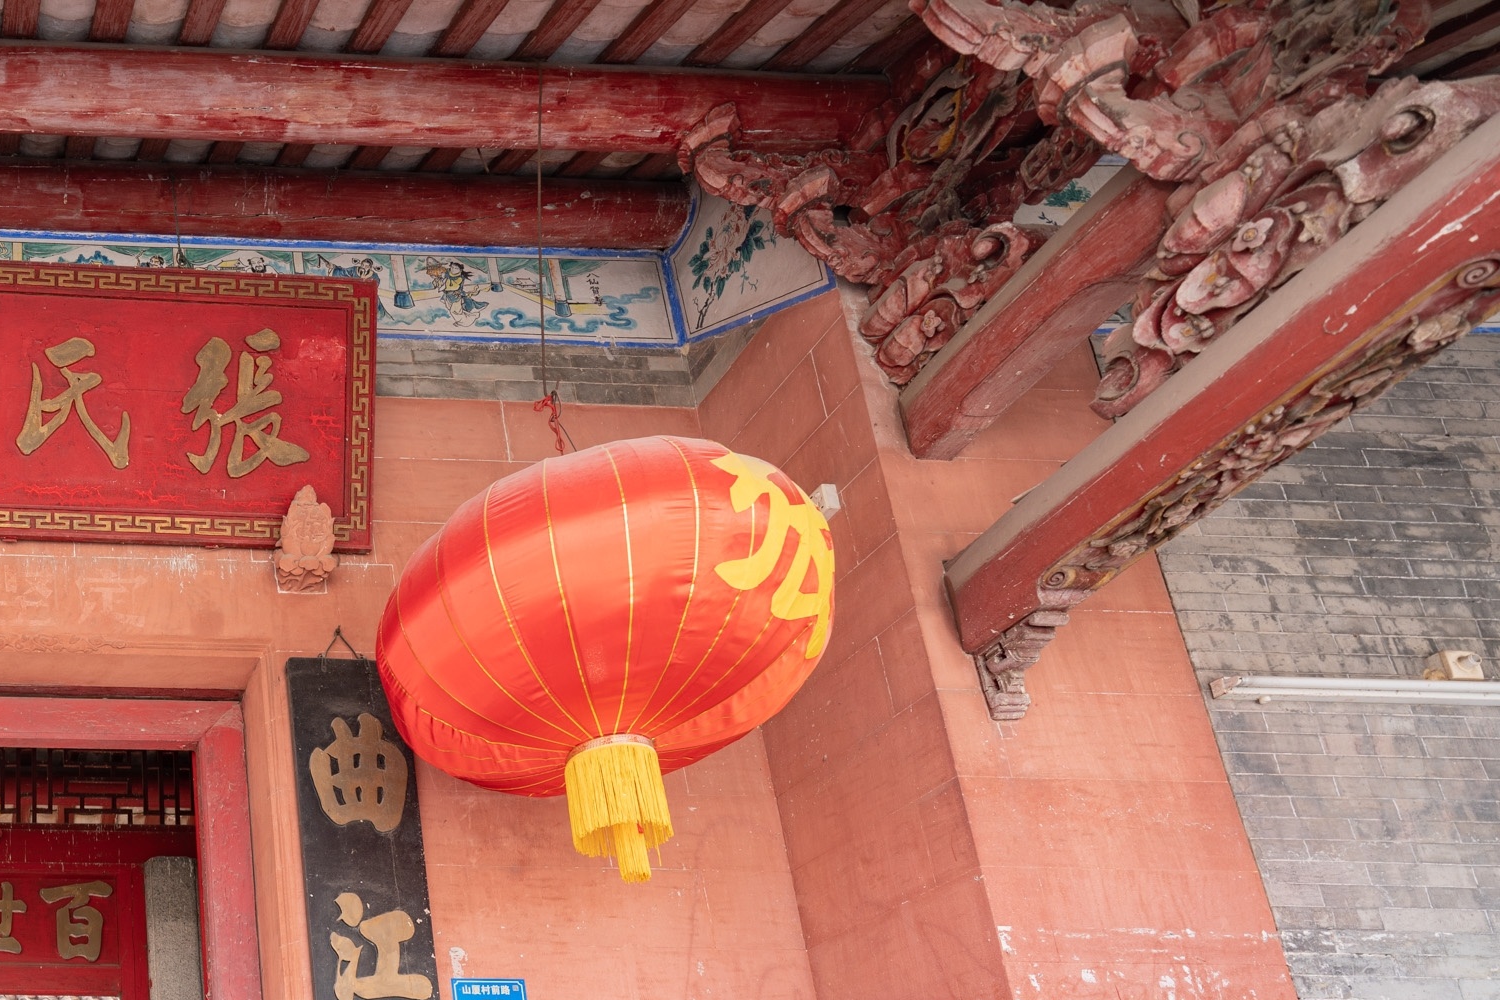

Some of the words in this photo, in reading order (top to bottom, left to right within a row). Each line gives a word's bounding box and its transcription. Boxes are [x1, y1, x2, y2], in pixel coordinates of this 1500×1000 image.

[461, 984, 511, 996] 山厦村前路
